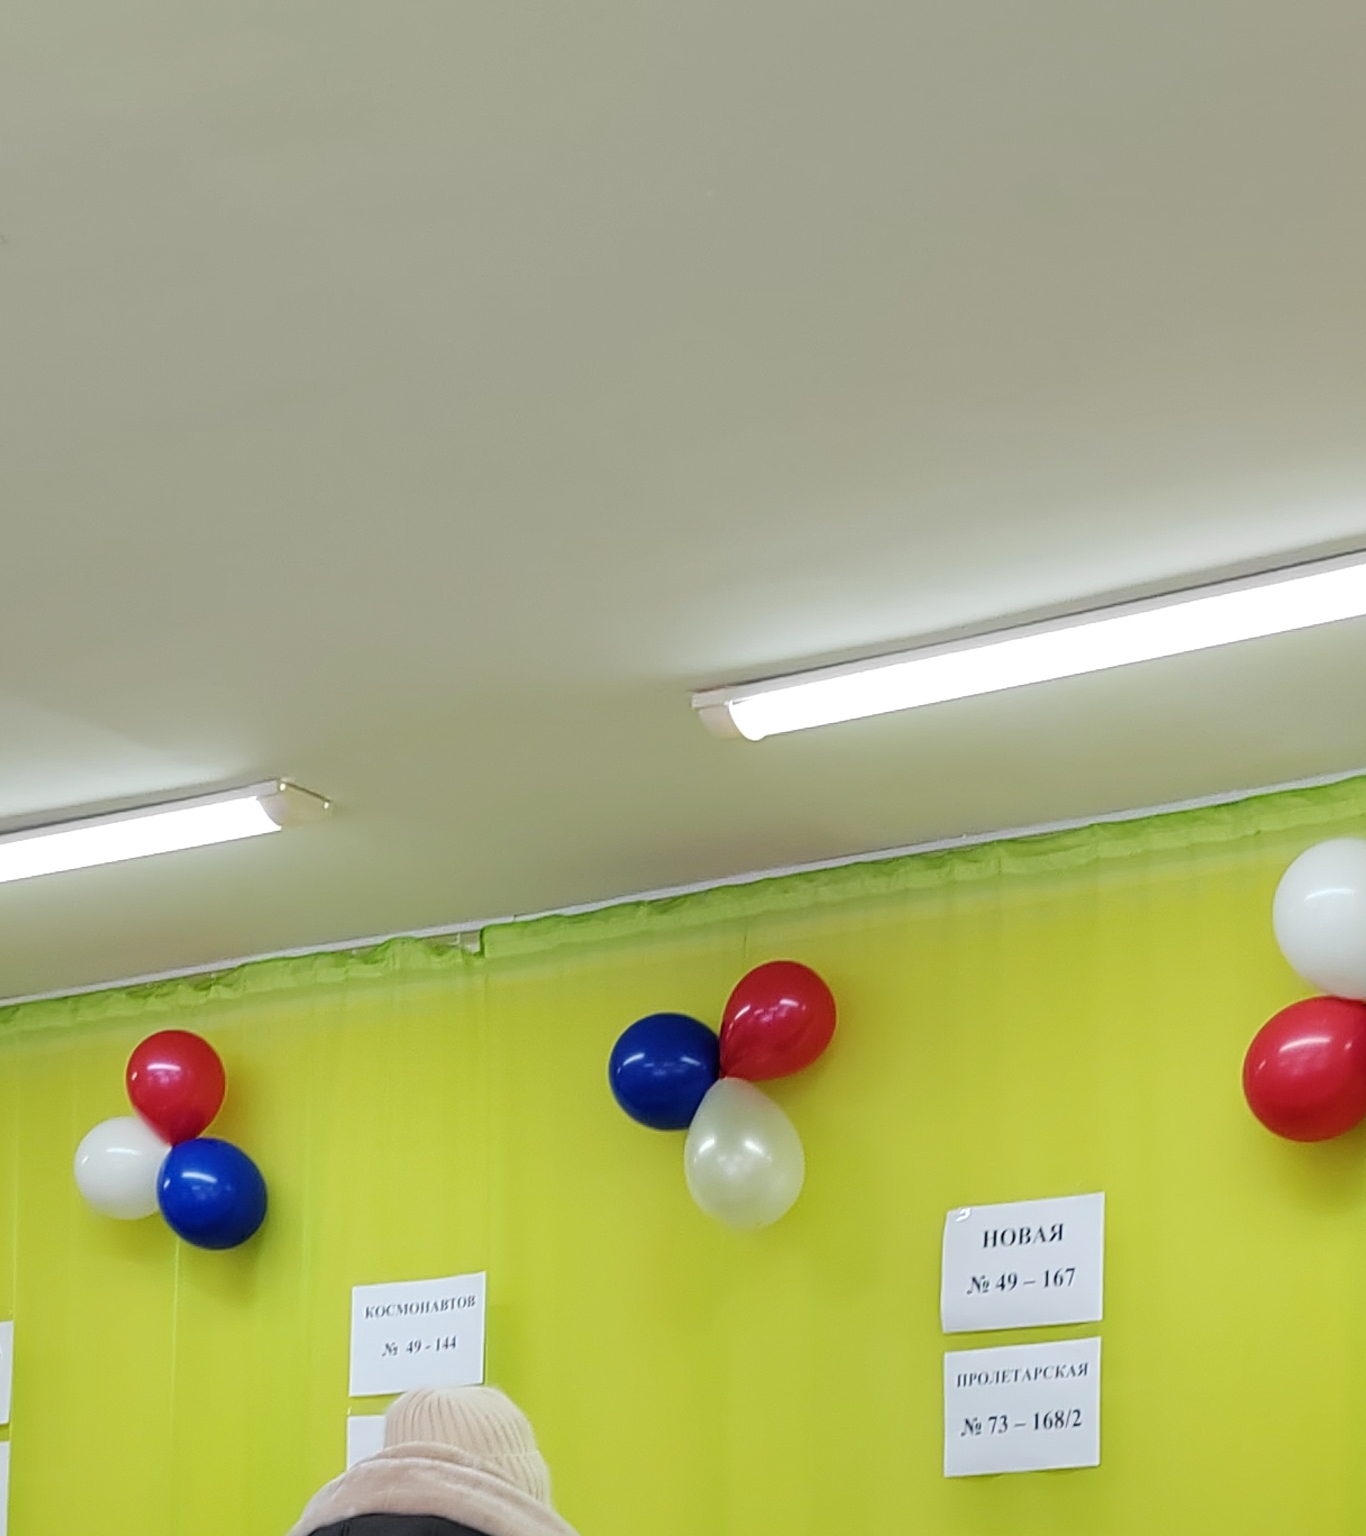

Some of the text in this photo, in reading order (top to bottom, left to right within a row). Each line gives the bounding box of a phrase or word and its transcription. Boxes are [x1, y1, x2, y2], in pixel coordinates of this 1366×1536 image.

[982, 1222, 1065, 1249] НОВАЯ
[965, 1273, 991, 1296] №
[995, 1271, 1019, 1292] 49
[1041, 1266, 1077, 1289] 167
[364, 1294, 477, 1320] КОСМОНАВТОВ
[380, 1340, 400, 1358] №
[404, 1339, 423, 1356] 49
[434, 1334, 458, 1353] 144
[955, 1361, 1090, 1389] ПРОЛЕТАРСКАЯ
[959, 1415, 983, 1438] №
[986, 1413, 1010, 1435] 73
[1031, 1407, 1083, 1432] 168/2
